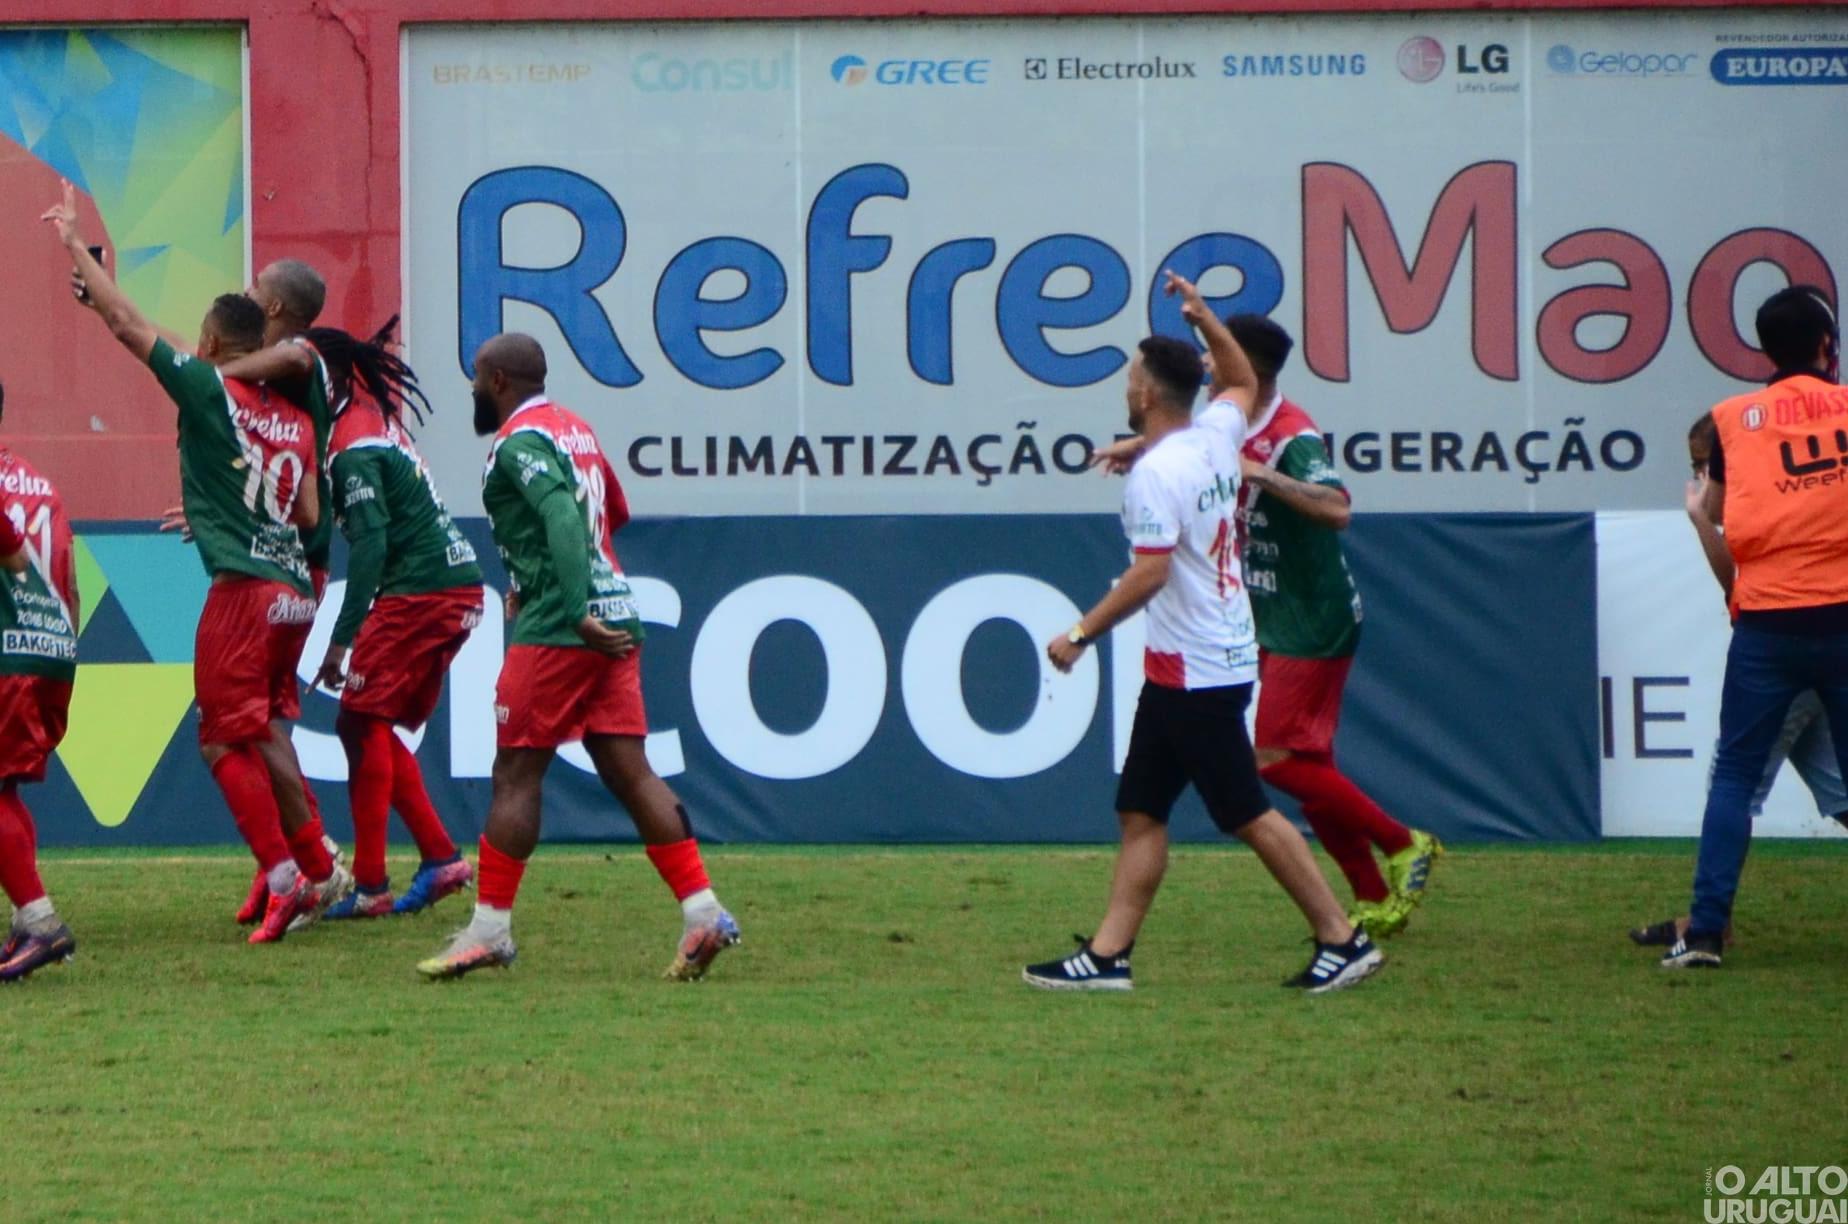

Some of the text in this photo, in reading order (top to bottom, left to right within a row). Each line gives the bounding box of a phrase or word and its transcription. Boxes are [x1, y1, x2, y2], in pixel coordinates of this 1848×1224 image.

[631, 50, 794, 94] Consul
[875, 59, 990, 85] GREE
[1056, 56, 1197, 81] Electrolux
[1222, 54, 1367, 78] SAMSUNG
[1457, 43, 1510, 74] LG
[1579, 49, 1698, 77] Gelopar
[432, 64, 591, 85] BRASTEMP
[231, 400, 301, 444] creluz
[627, 421, 1098, 486] CLIMATIZAÇÃO
[240, 440, 303, 526] 10
